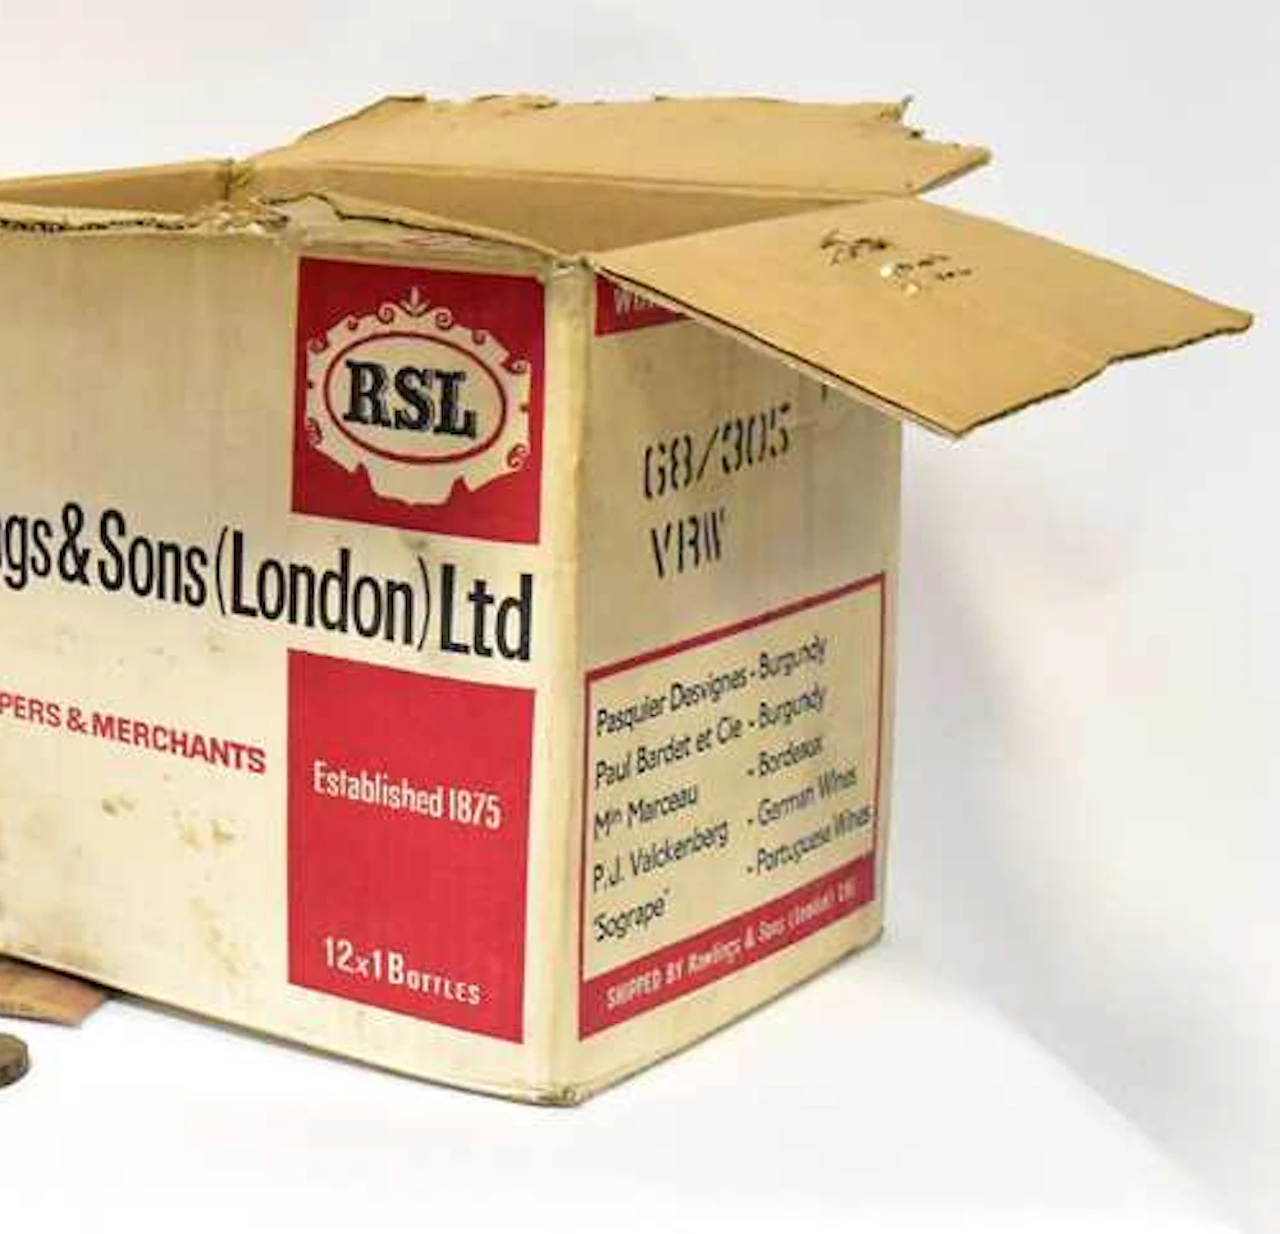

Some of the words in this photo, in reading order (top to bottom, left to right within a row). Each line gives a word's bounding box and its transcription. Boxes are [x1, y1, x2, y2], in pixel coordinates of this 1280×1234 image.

[342, 360, 478, 440] RSL
[57, 502, 91, 586] &
[97, 508, 208, 607] Sons
[216, 525, 431, 652] (London)
[440, 563, 533, 661] Ltd
[596, 694, 667, 738] Pasquier
[670, 668, 748, 712] Desvignes
[759, 635, 828, 679] Burgundy
[66, 706, 89, 733] &
[92, 711, 268, 776] MERCHANTS
[595, 750, 632, 789] Paul
[637, 735, 692, 774] Bardet
[696, 727, 713, 753] et
[716, 716, 743, 745] Cie
[759, 682, 828, 729] Burgundy
[313, 759, 444, 819] Established
[449, 788, 502, 830] 1875
[627, 784, 700, 829] Marceau
[628, 819, 729, 877] Valckenberg
[757, 786, 816, 827] German
[757, 824, 832, 876] Portuguese
[833, 804, 872, 838] Wines
[325, 935, 383, 981] 12x1
[605, 966, 663, 1010] SHIPPED
[665, 958, 685, 986] BY
